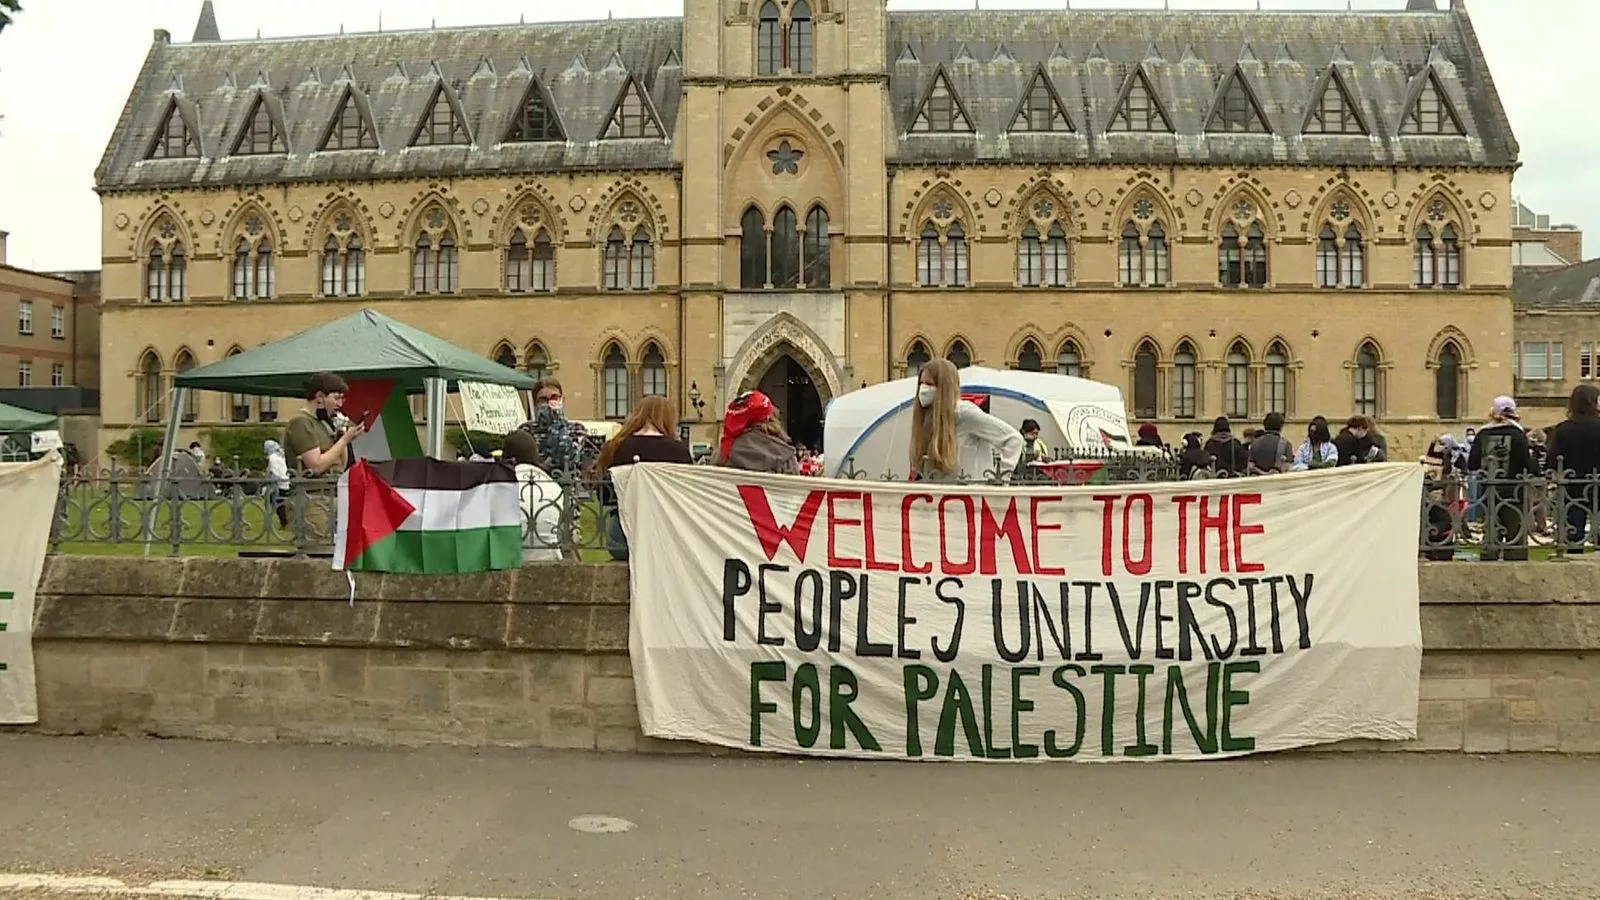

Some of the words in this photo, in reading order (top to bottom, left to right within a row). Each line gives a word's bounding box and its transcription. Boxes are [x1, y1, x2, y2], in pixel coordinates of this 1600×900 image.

[737, 485, 1065, 576] WELCOME
[1093, 494, 1154, 577] TO
[1172, 494, 1265, 574] THE
[723, 559, 965, 663] PEOPLE'S
[991, 574, 1314, 663] UNIVERSITY
[751, 661, 881, 752] FOR
[904, 661, 1261, 758] PALESTINE
